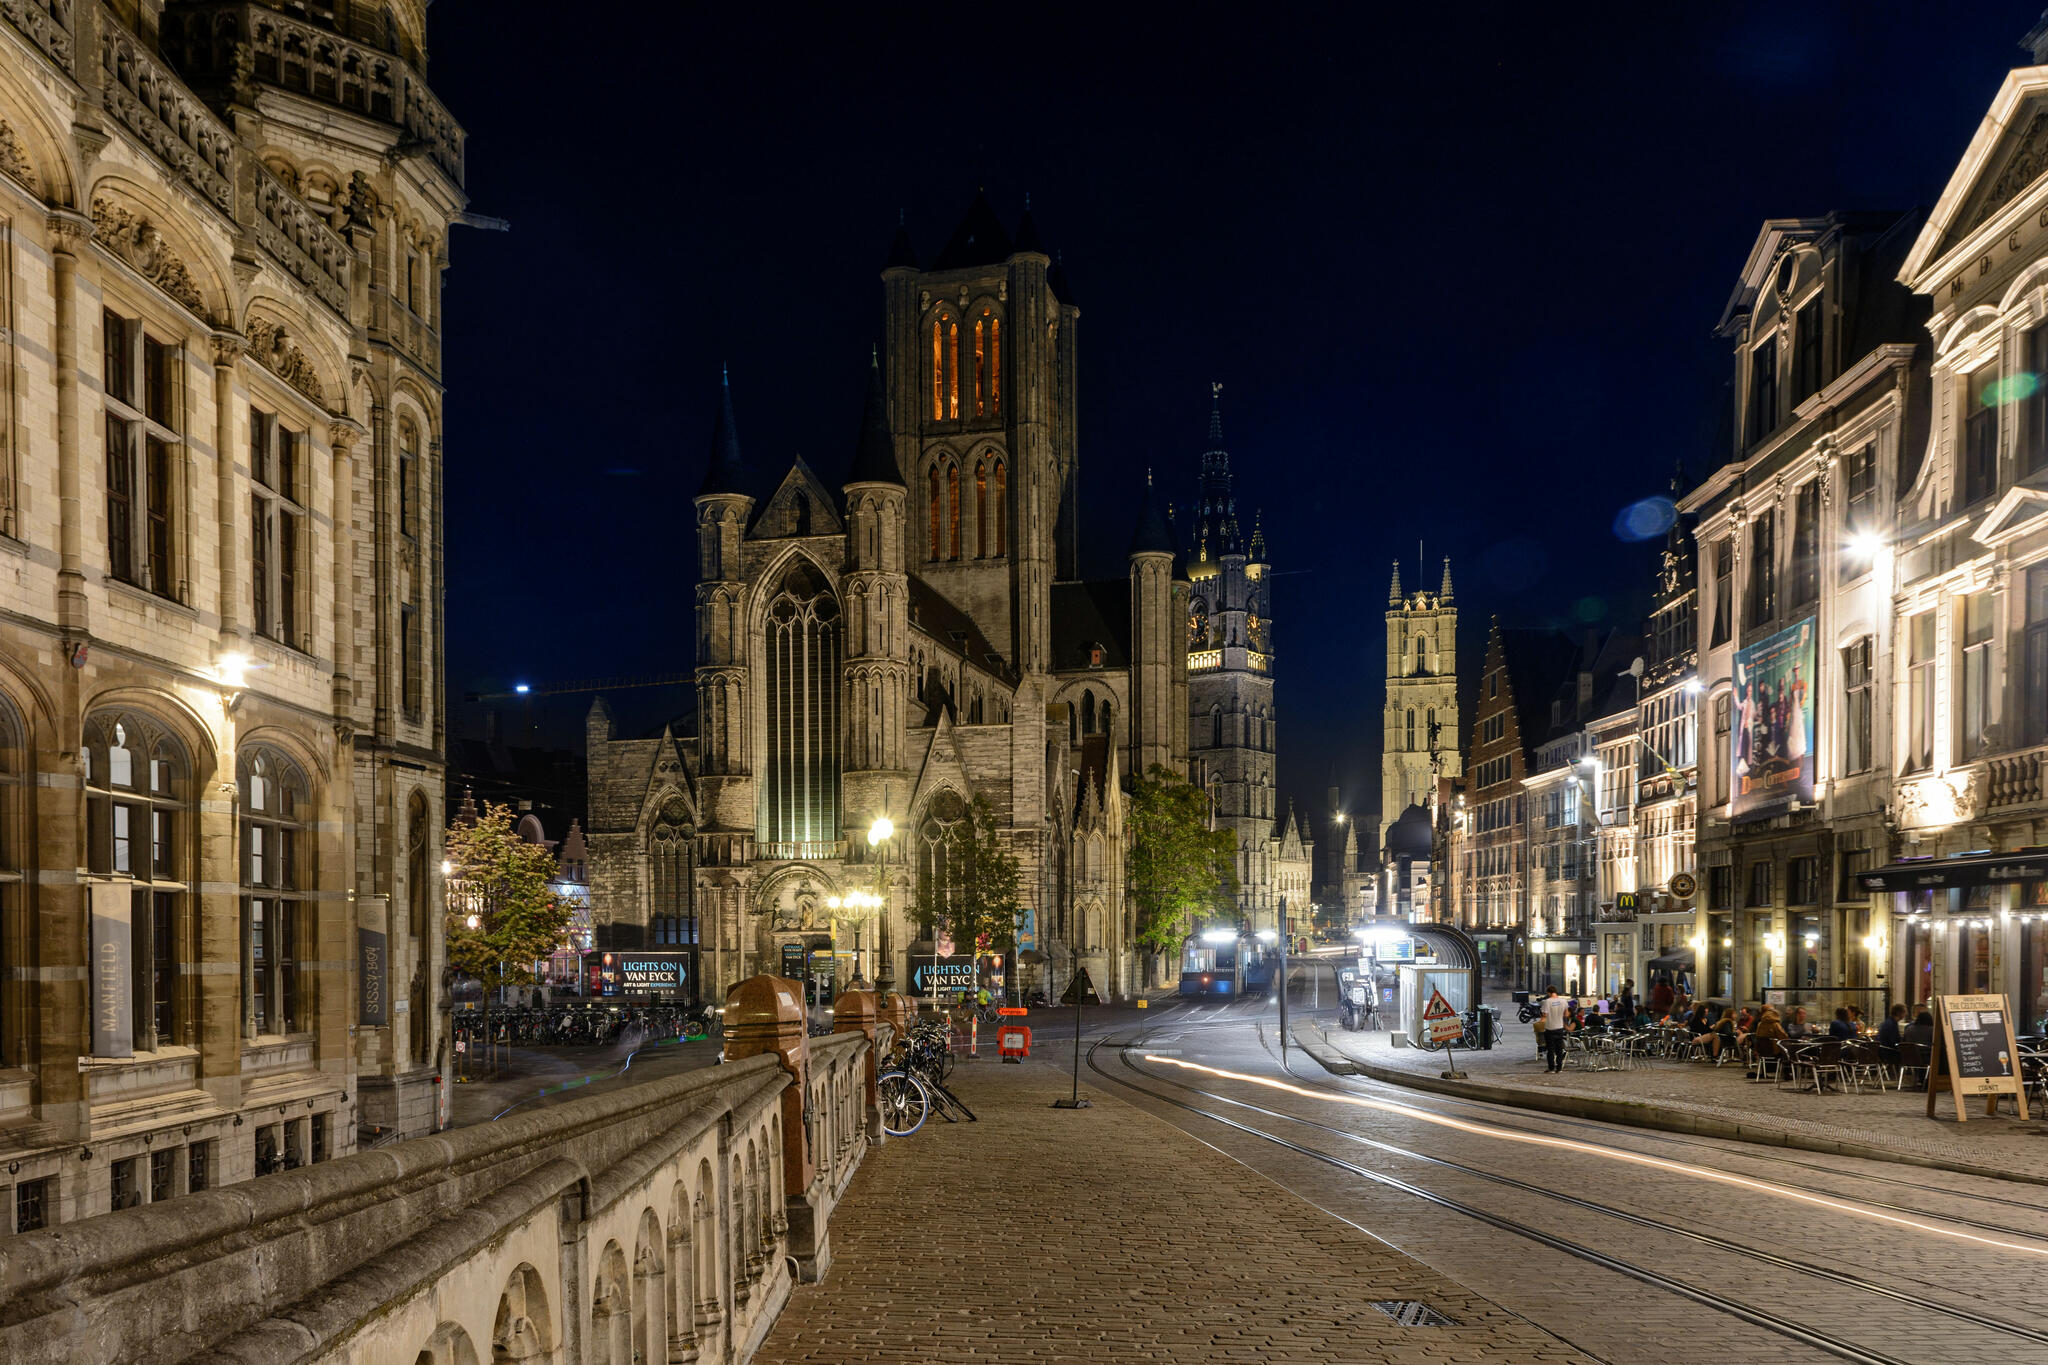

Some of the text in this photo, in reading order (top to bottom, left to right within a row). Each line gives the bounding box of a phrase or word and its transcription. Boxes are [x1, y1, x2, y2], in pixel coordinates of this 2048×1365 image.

[623, 962, 677, 971] LIGHTS ON
[923, 965, 960, 974] LIGHTS
[625, 972, 675, 981] VAN EYCK
[926, 976, 977, 985] VAN EYC
[101, 942, 116, 1032] MANFIELD
